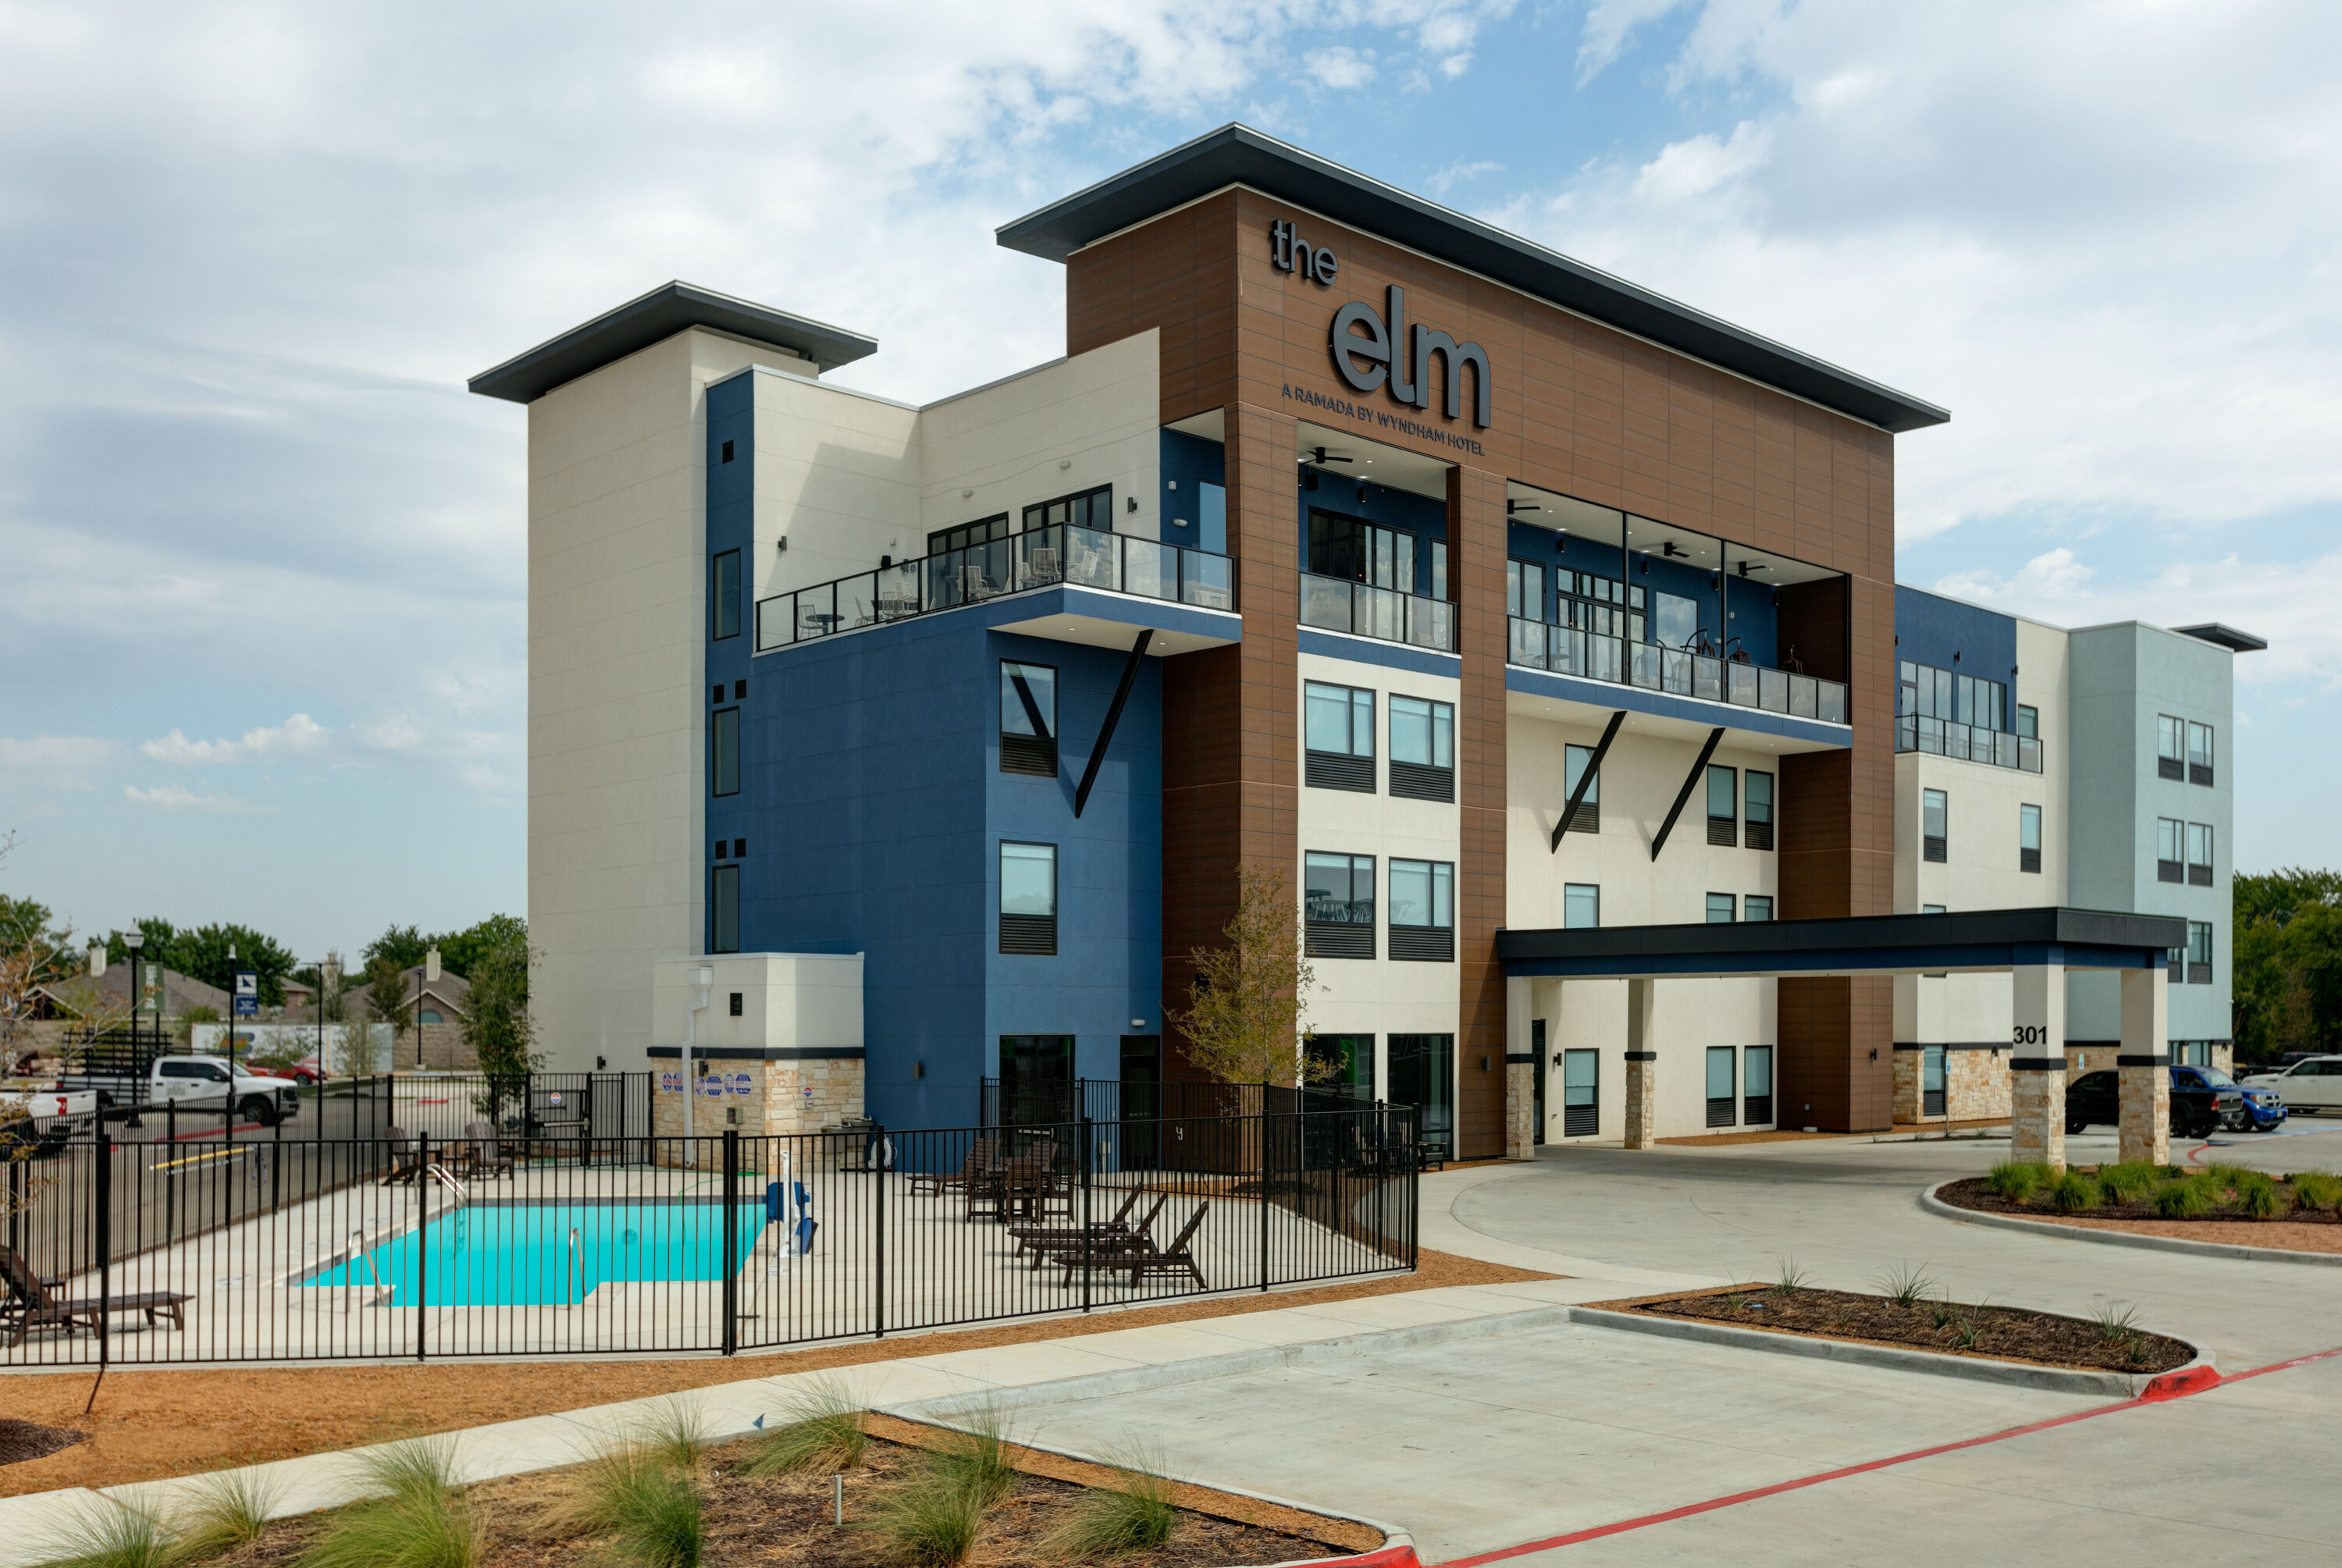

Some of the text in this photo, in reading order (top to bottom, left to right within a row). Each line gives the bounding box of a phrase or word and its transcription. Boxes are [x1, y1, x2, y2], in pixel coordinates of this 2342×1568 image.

[1270, 219, 1339, 286] the
[1329, 284, 1491, 429] elm
[1282, 383, 1486, 457] A RAMADA BY WYNDHAM HOTEL
[2013, 1026, 2047, 1044] 301
